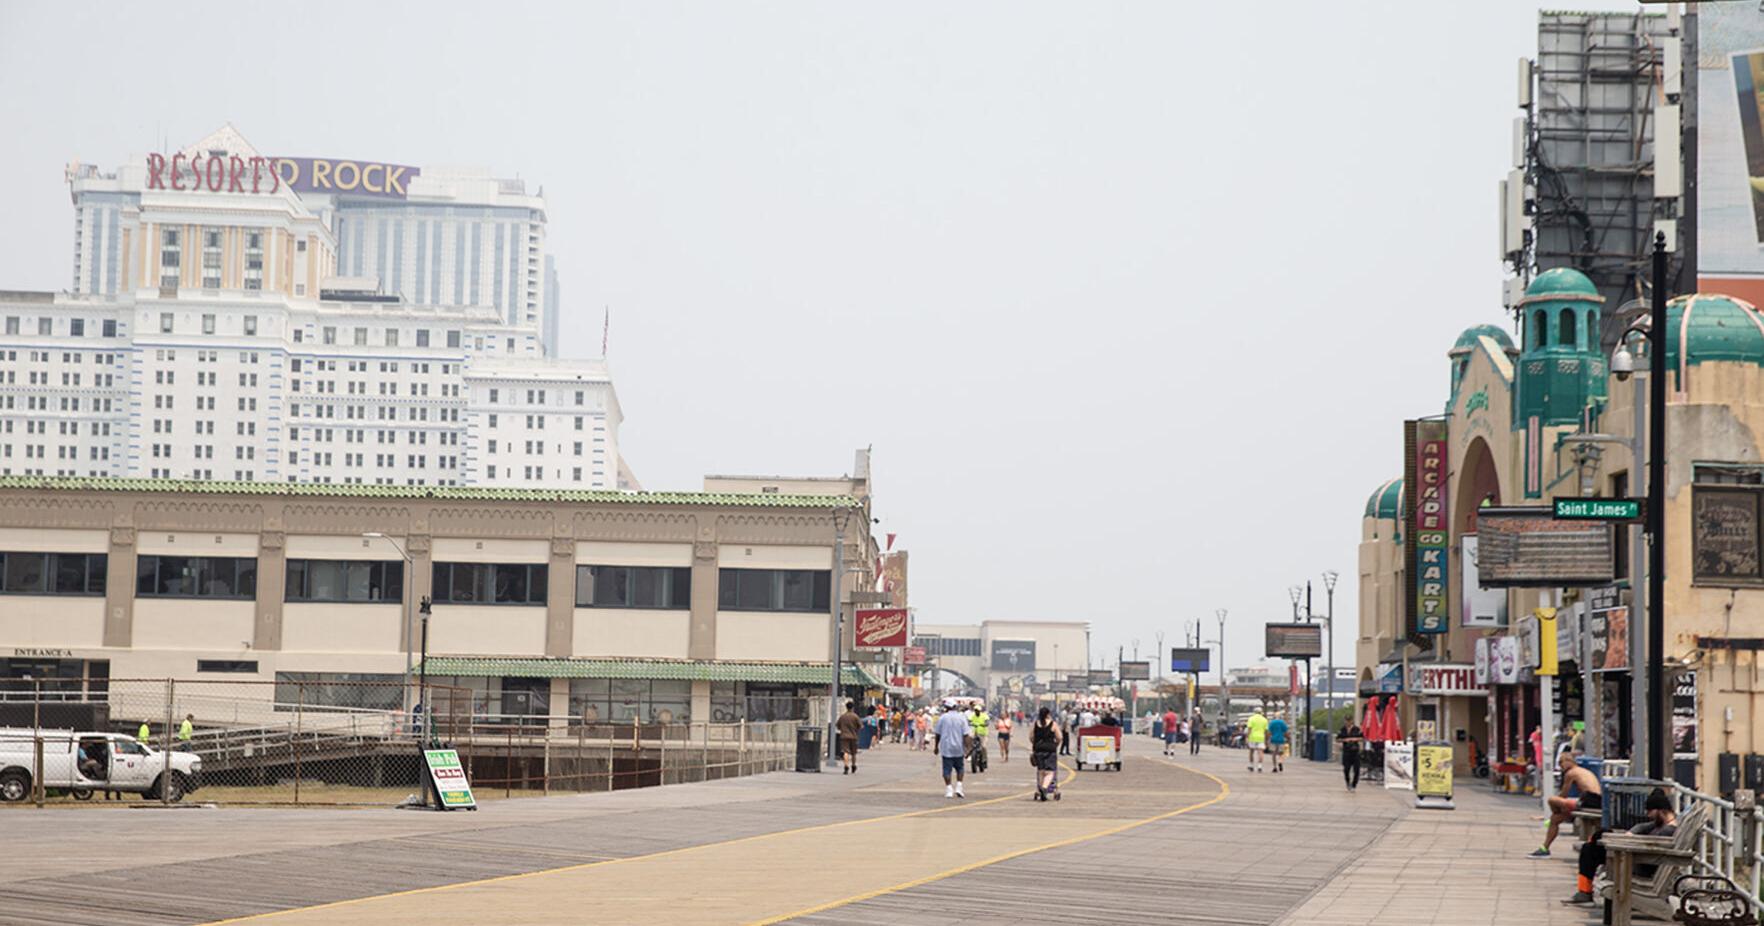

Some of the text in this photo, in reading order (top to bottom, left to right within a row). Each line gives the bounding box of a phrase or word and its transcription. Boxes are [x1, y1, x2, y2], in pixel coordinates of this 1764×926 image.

[148, 153, 280, 194] RESORTS
[312, 159, 405, 195] ROCK
[1557, 502, 1587, 515] Saint
[1590, 503, 1628, 516] James
[1419, 443, 1443, 630] ARCADE GO KARTS
[14, 648, 61, 656] ENTRANCE
